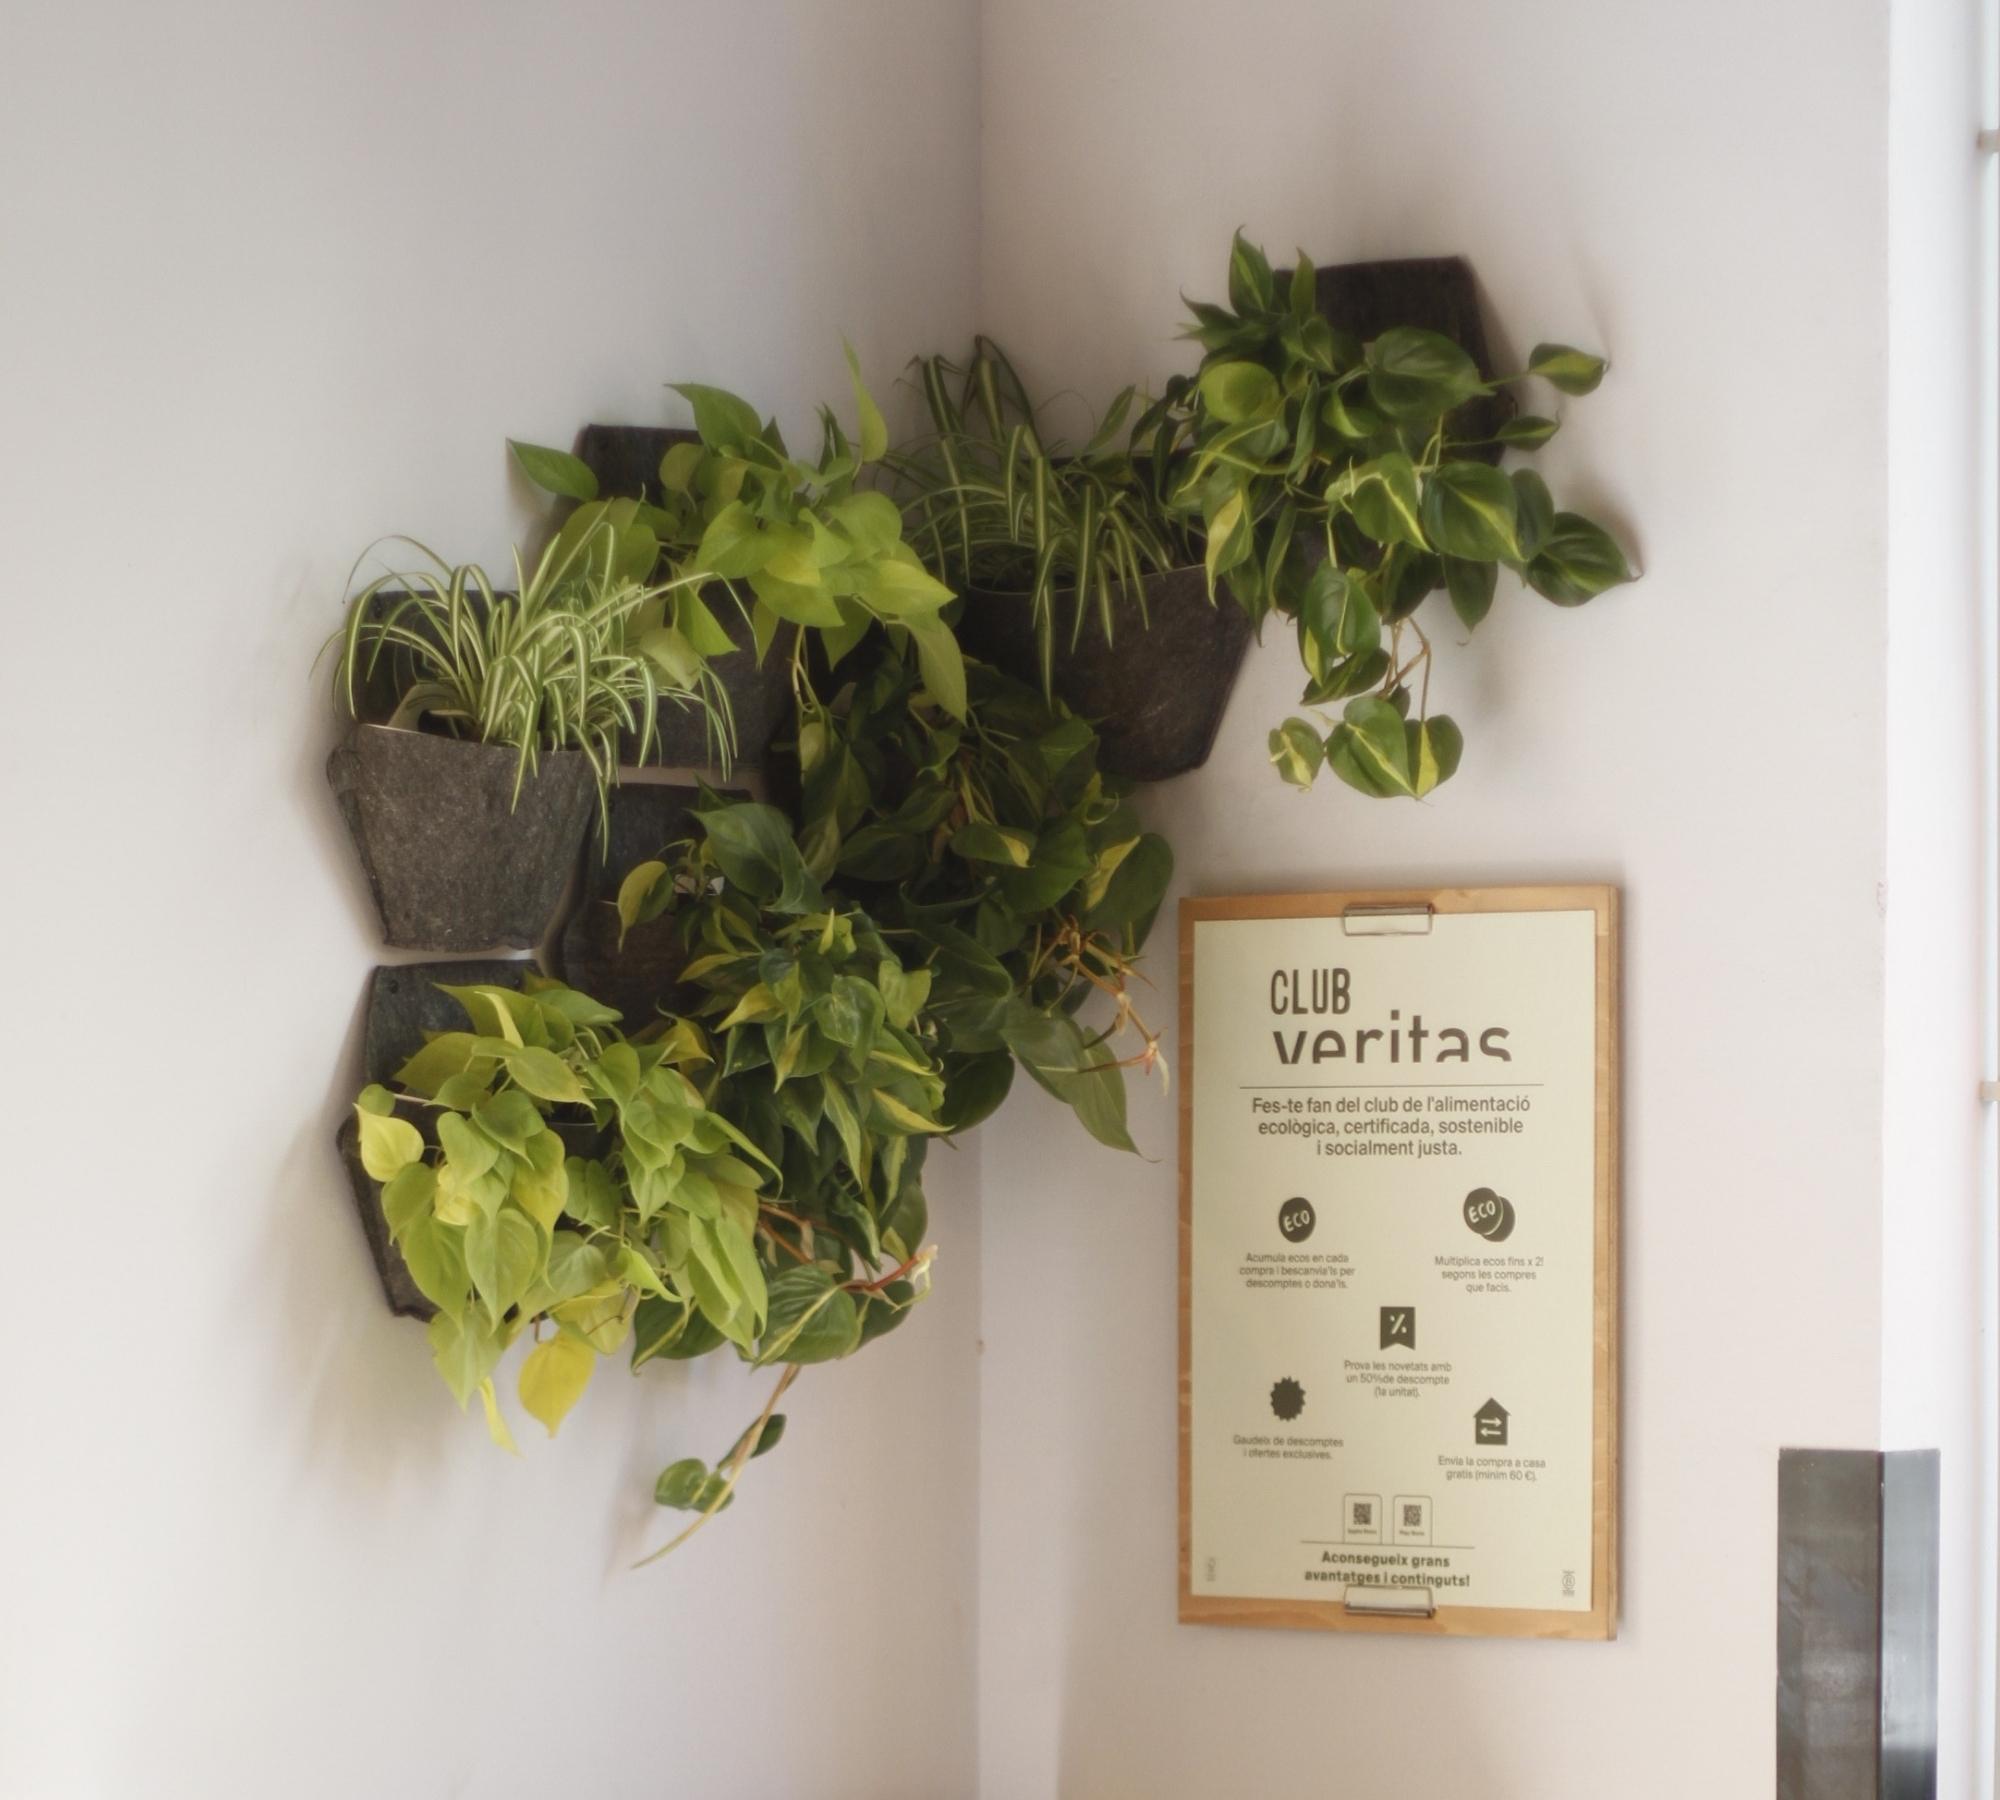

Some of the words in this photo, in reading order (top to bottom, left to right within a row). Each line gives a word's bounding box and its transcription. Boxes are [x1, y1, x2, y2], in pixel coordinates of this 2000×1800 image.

[1270, 967, 1351, 1015] CLUB
[1273, 1009, 1512, 1064] veritas
[1252, 1097, 1304, 1114] Fes-te
[1307, 1097, 1332, 1113] fan
[1336, 1096, 1360, 1113] del
[1364, 1096, 1398, 1112] club
[1403, 1096, 1423, 1112] de
[1427, 1095, 1530, 1112] l'alimentació
[1258, 1119, 1340, 1137] ecològica,
[1343, 1119, 1434, 1136] certificada,
[1438, 1118, 1523, 1134] sostenible
[1325, 1140, 1413, 1156] socialment
[1418, 1140, 1462, 1158] justa.
[1468, 1200, 1496, 1223] ECO
[1283, 1210, 1310, 1232] ECO
[1246, 1253, 1286, 1262] Acumula
[1326, 1253, 1349, 1262] cada
[1435, 1256, 1480, 1267] Multiplica
[1483, 1258, 1505, 1266] ecos
[1508, 1257, 1525, 1266] fins
[1240, 1268, 1275, 1277] compra
[1340, 1268, 1355, 1277] per
[1442, 1272, 1476, 1280] segons
[1478, 1271, 1492, 1279] les
[1494, 1272, 1536, 1280] compres
[1246, 1279, 1303, 1290] descomptes
[1466, 1284, 1484, 1293] que
[1344, 1361, 1370, 1370] Prova
[1372, 1361, 1386, 1370] les
[1388, 1363, 1428, 1371] novetats
[1431, 1362, 1452, 1372] amb
[1346, 1375, 1358, 1383] un
[1397, 1374, 1450, 1386] descompte
[1273, 1436, 1284, 1446] de
[1287, 1437, 1343, 1448] descomptes
[1438, 1456, 1463, 1466] Envia
[1466, 1457, 1474, 1466] la
[1476, 1459, 1512, 1469] compra
[1446, 1469, 1473, 1481] gratis
[1510, 1471, 1522, 1480] 60
[1322, 1551, 1408, 1567] Aconsegueix
[1412, 1556, 1450, 1568] grans
[1305, 1570, 1380, 1584] avantatges
[1391, 1574, 1470, 1588] continguts!
